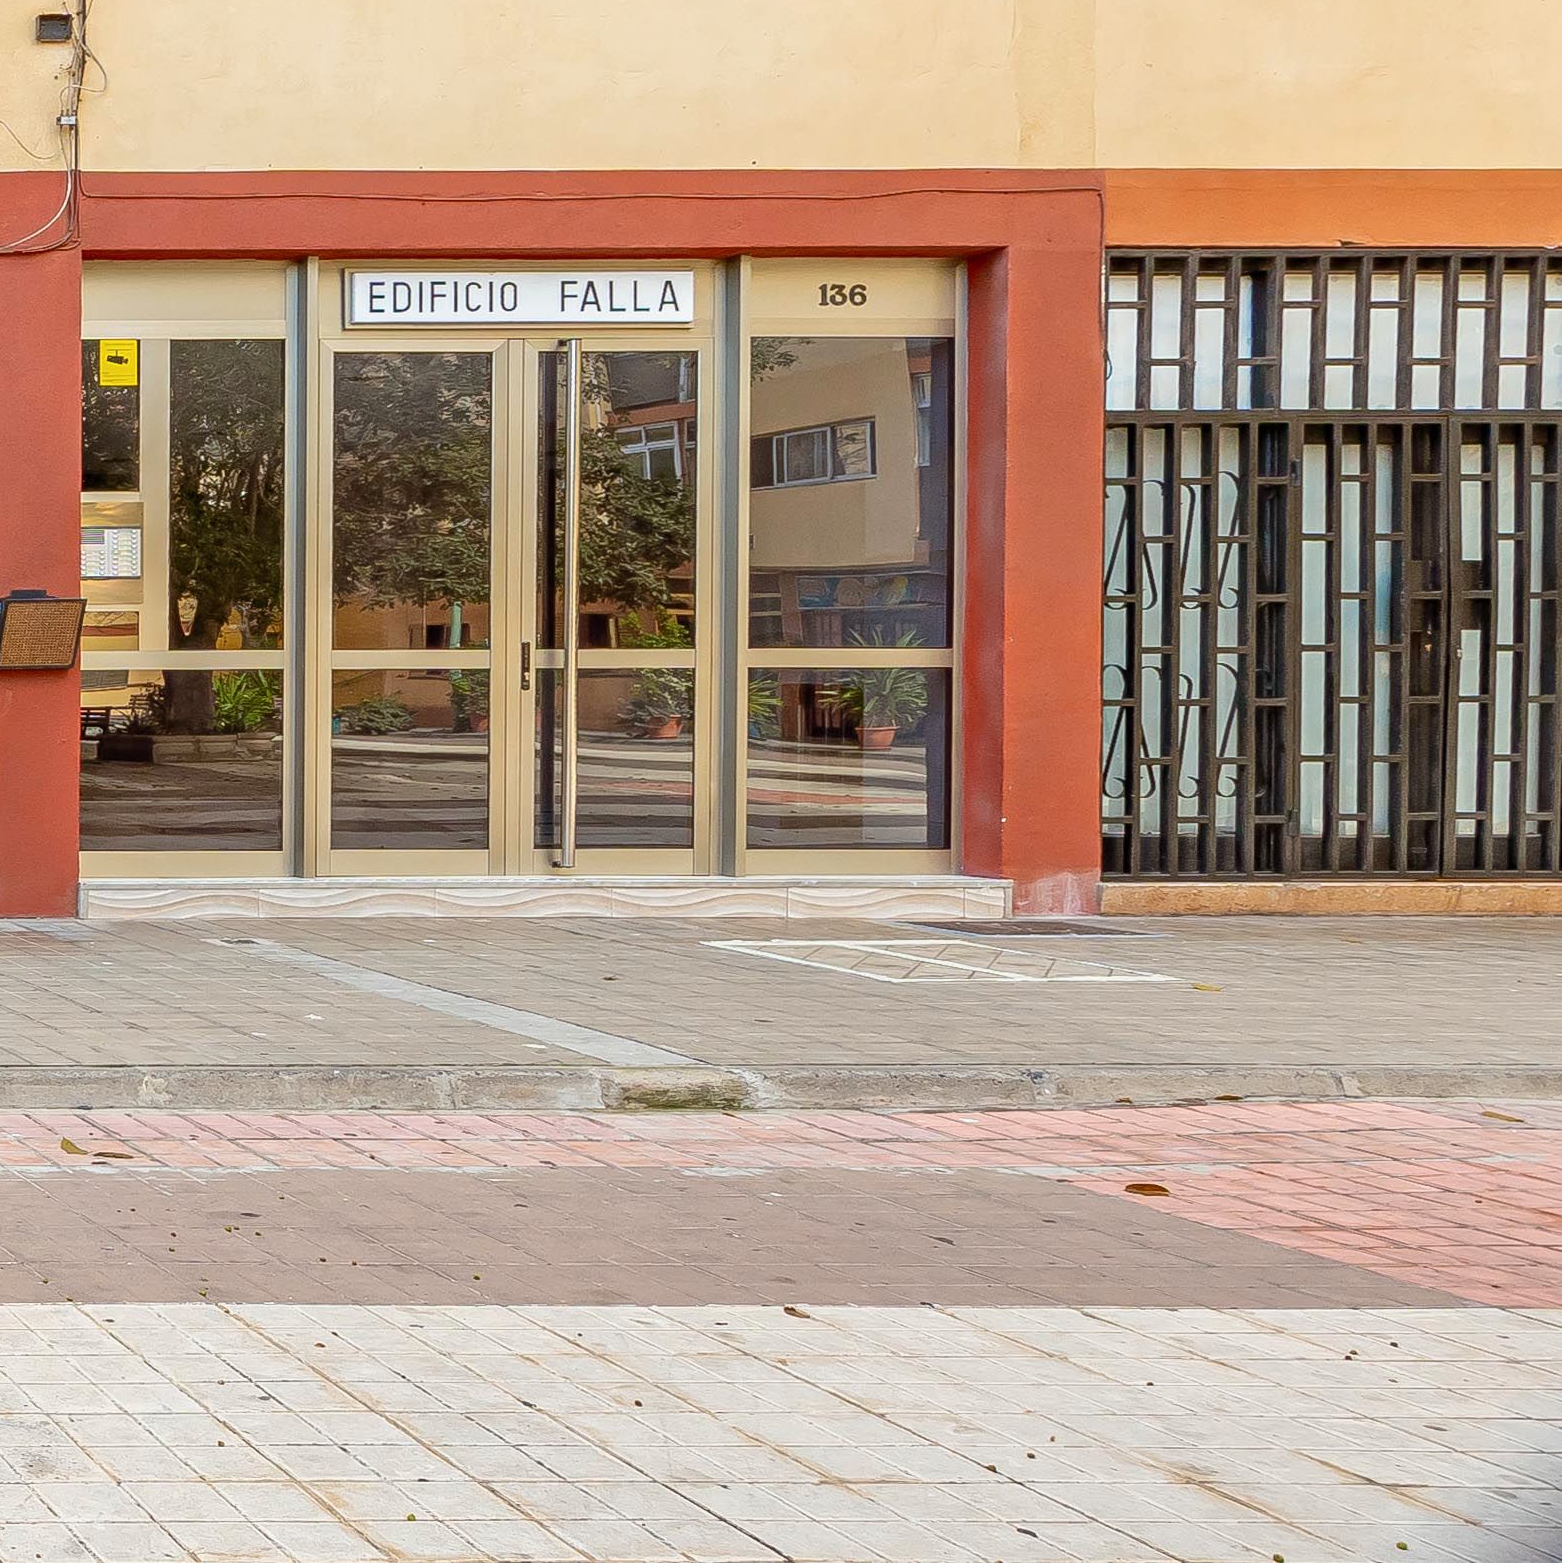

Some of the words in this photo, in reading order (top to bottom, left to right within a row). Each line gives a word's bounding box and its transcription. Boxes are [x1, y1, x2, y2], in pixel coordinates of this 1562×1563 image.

[368, 280, 519, 314] EDIFICIO
[559, 279, 681, 313] FALLA
[817, 282, 868, 308] 136
